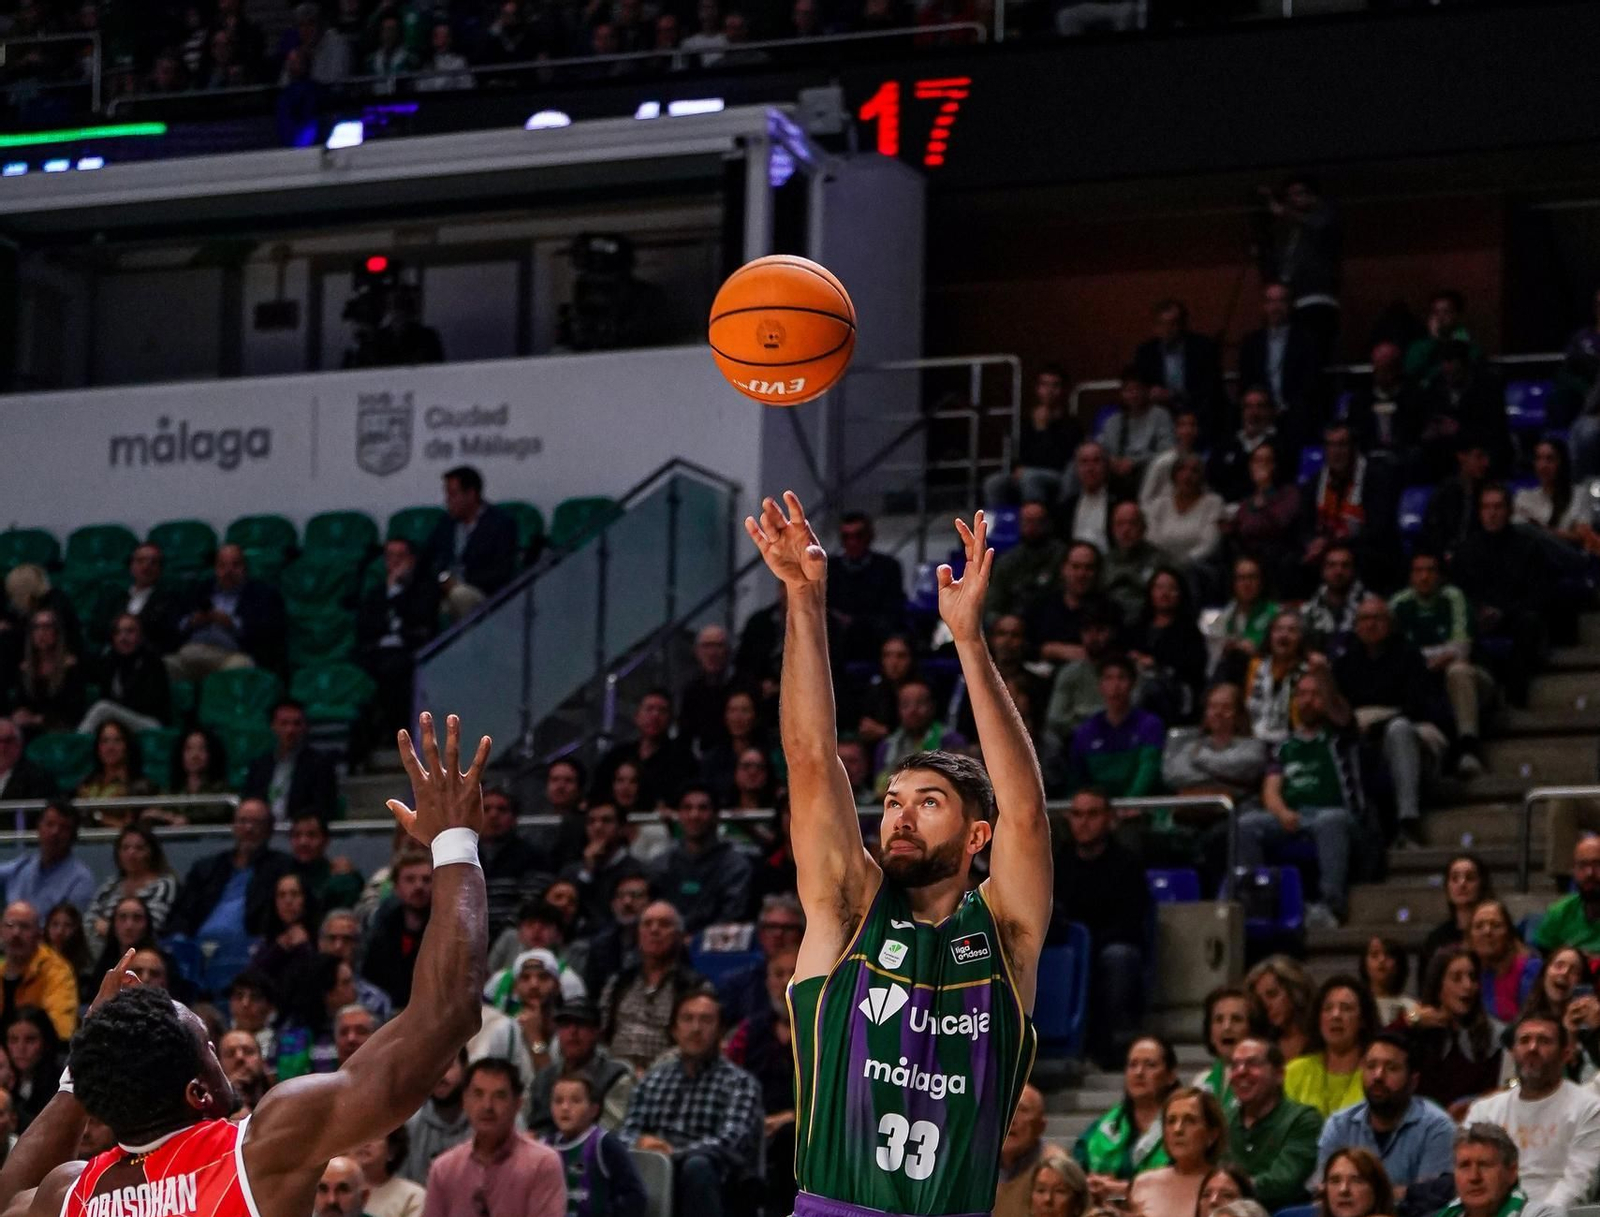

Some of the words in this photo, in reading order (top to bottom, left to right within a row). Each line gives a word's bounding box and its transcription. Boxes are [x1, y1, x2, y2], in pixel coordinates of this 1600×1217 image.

[859, 77, 972, 166] 17
[424, 404, 508, 430] Ciudad
[424, 438, 454, 459] de
[875, 1112, 940, 1181] 33
